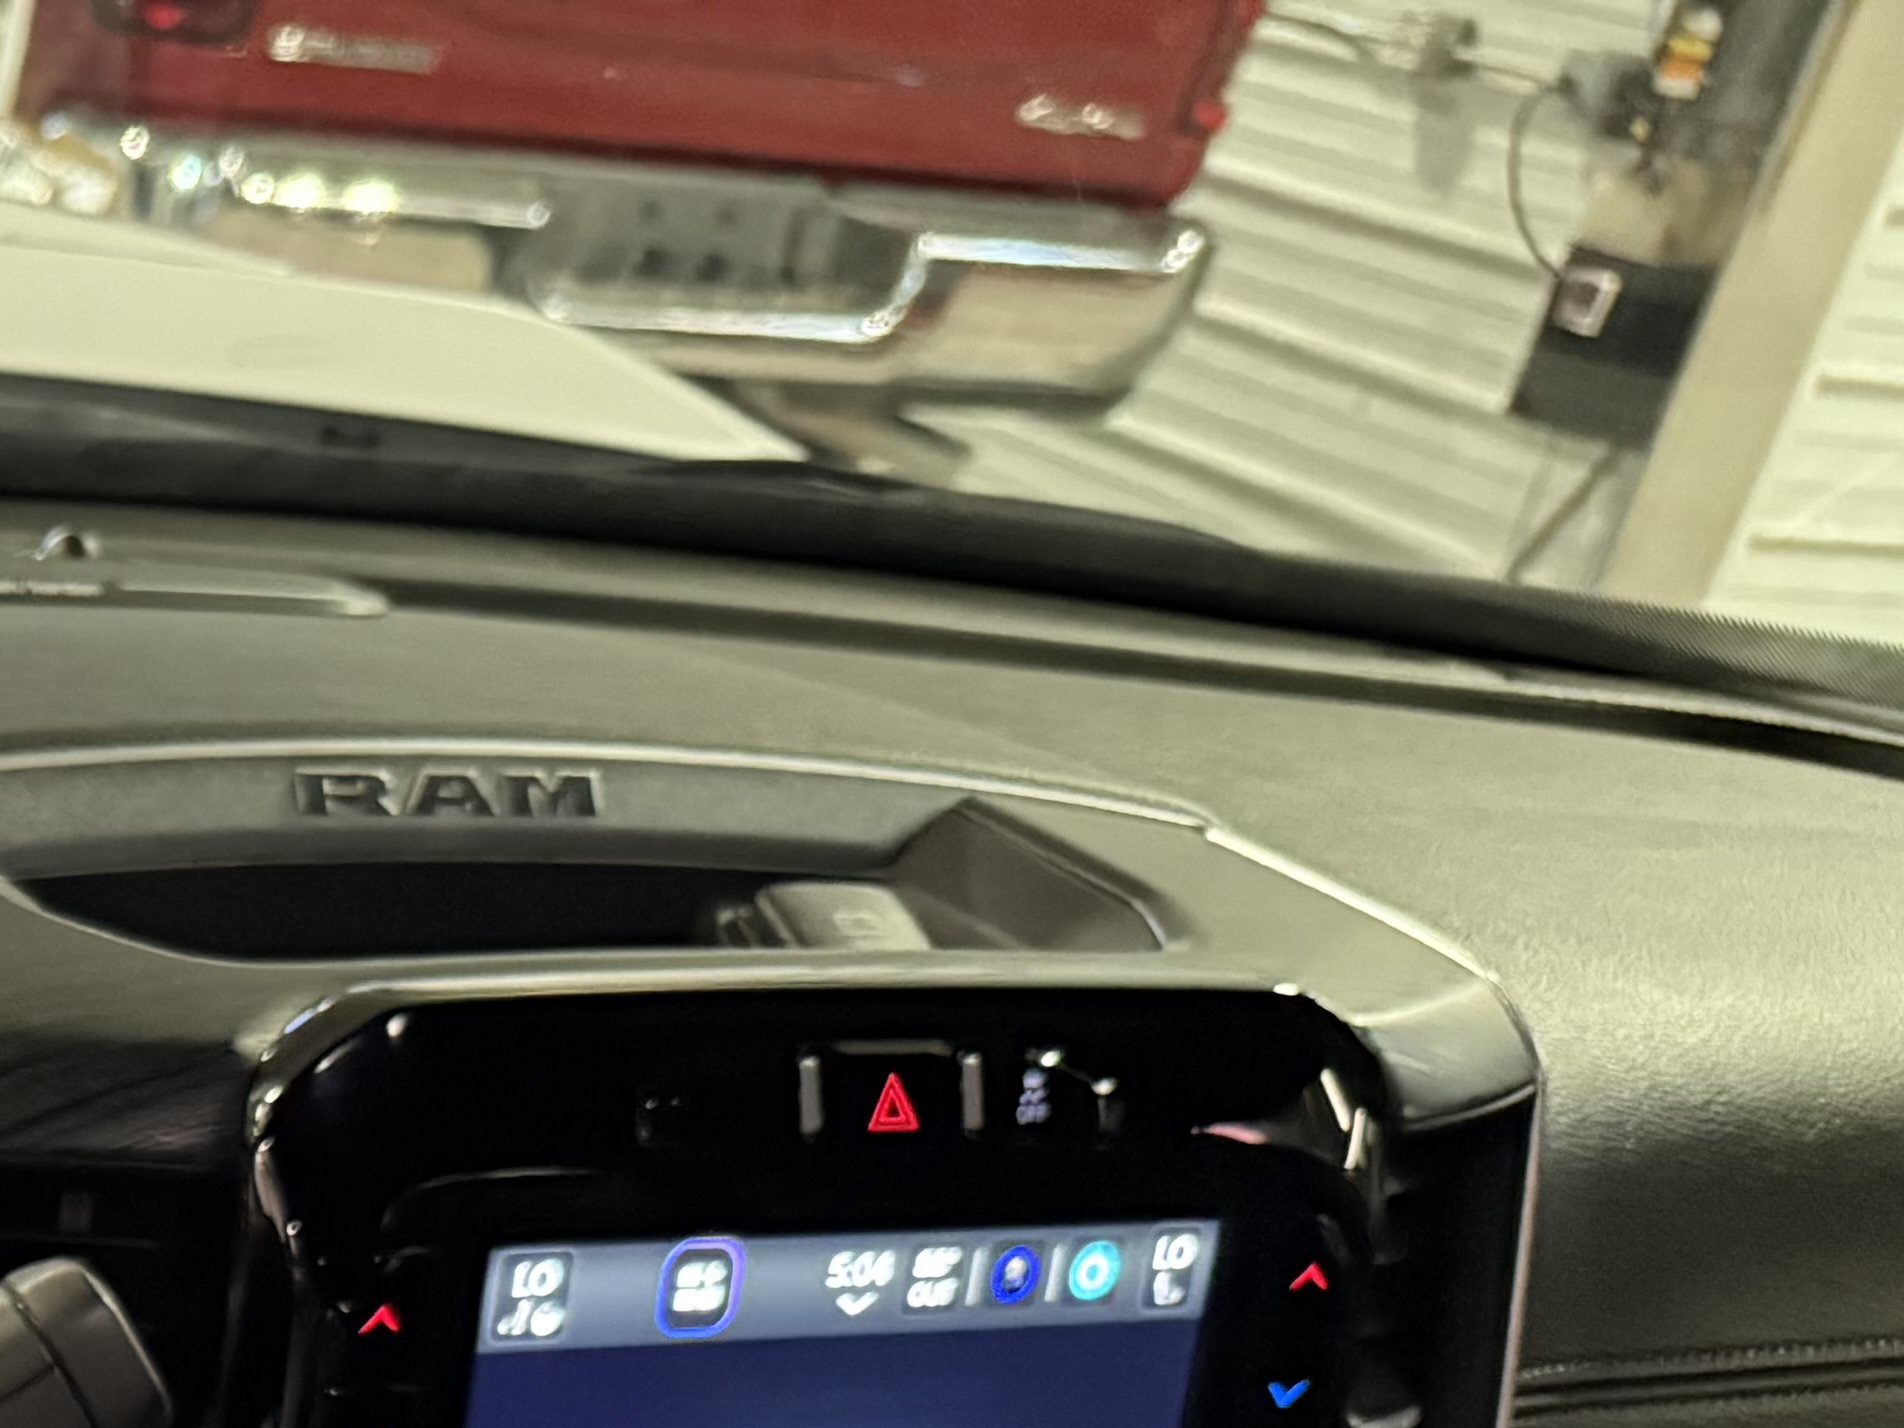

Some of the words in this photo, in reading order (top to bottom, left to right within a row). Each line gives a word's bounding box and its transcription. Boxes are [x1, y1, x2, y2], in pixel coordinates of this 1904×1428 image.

[294, 766, 605, 817] RAM
[1152, 1233, 1199, 1270] LO
[511, 1258, 565, 1298] LO
